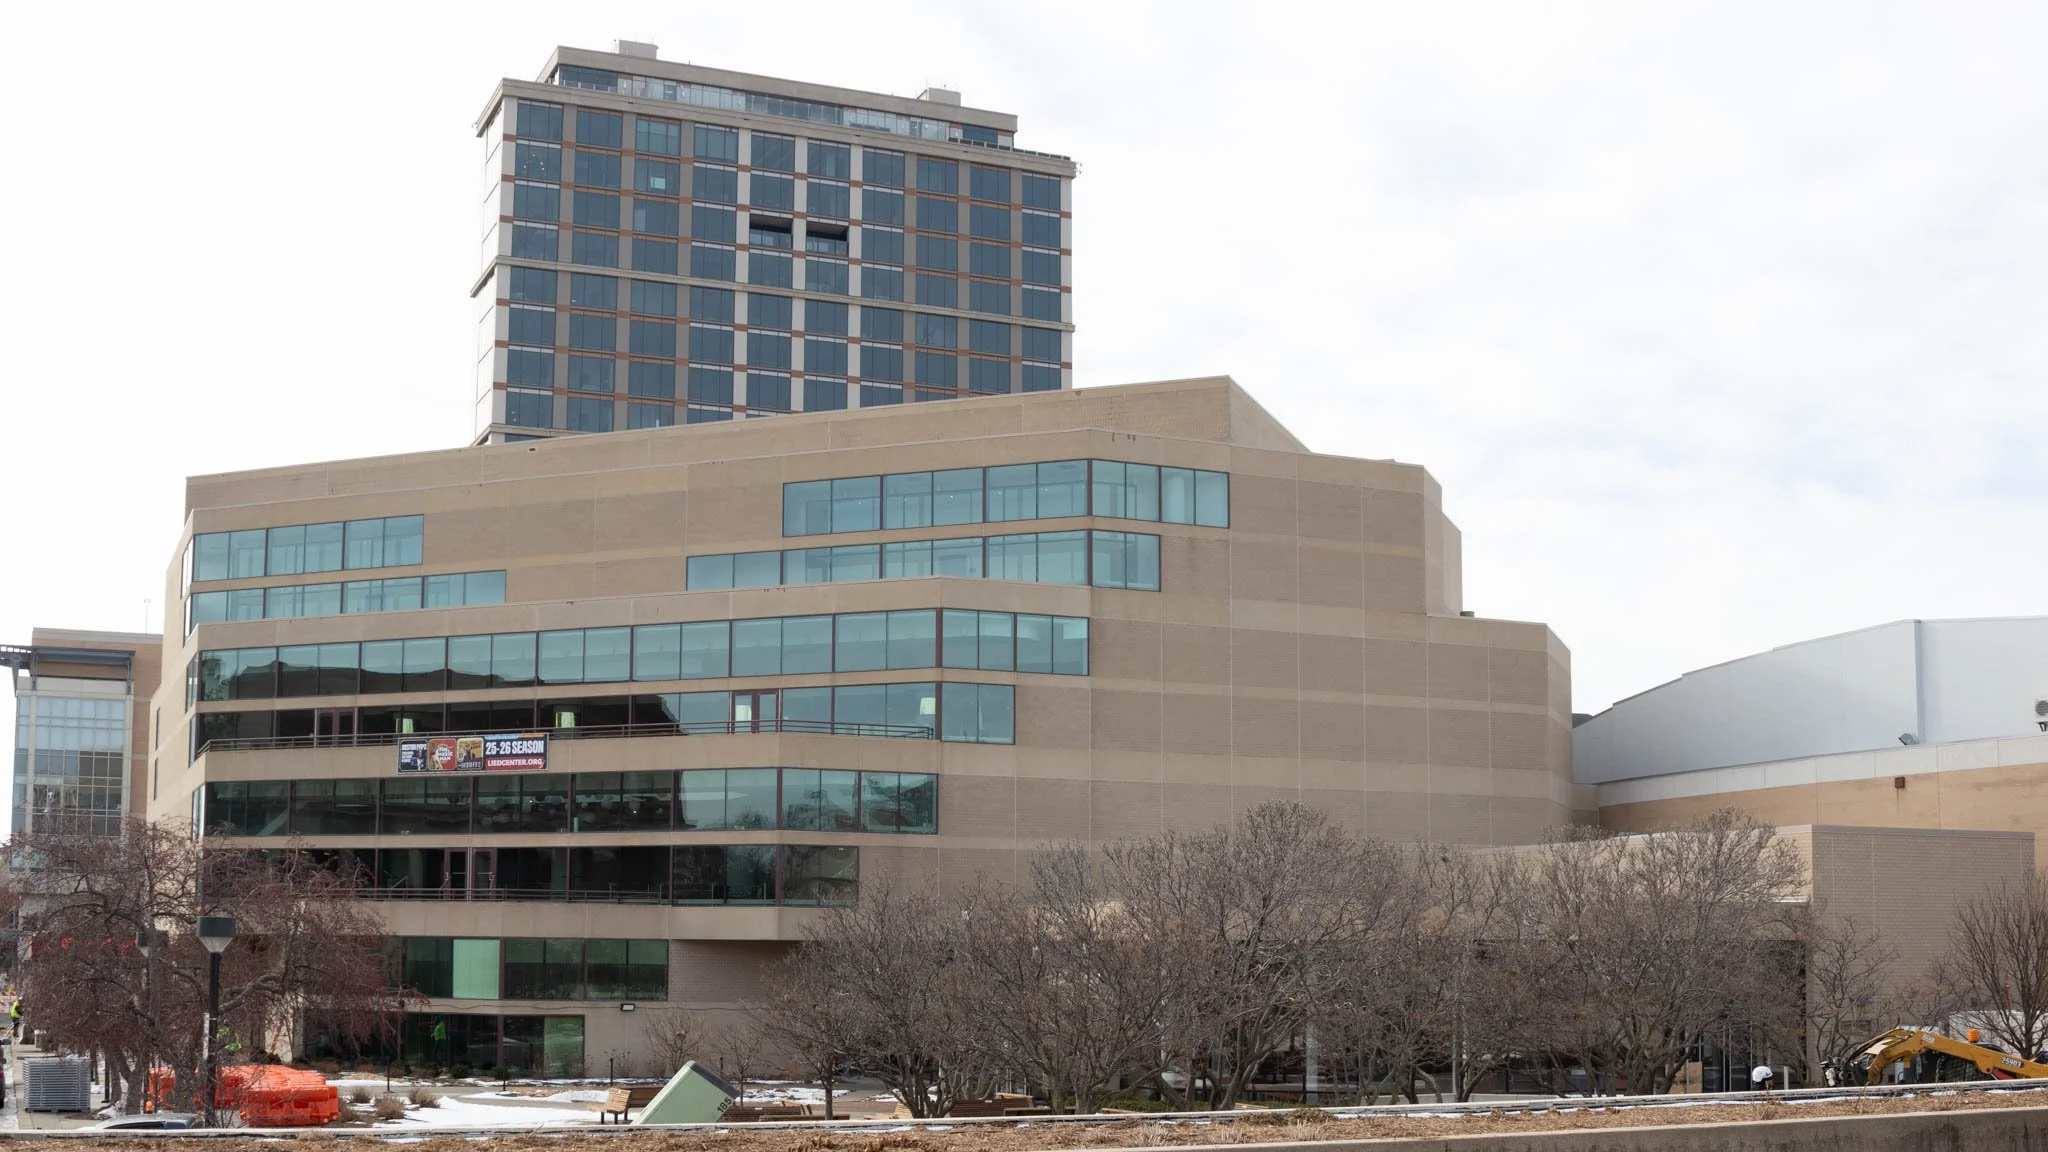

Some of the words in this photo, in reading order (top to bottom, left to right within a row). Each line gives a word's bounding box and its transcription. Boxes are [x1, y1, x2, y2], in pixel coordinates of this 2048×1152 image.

[485, 741, 511, 755] 25-26
[511, 740, 544, 754] SEASON
[487, 758, 543, 766] LIEDCENTER.ORG
[717, 1096, 732, 1113] 185
